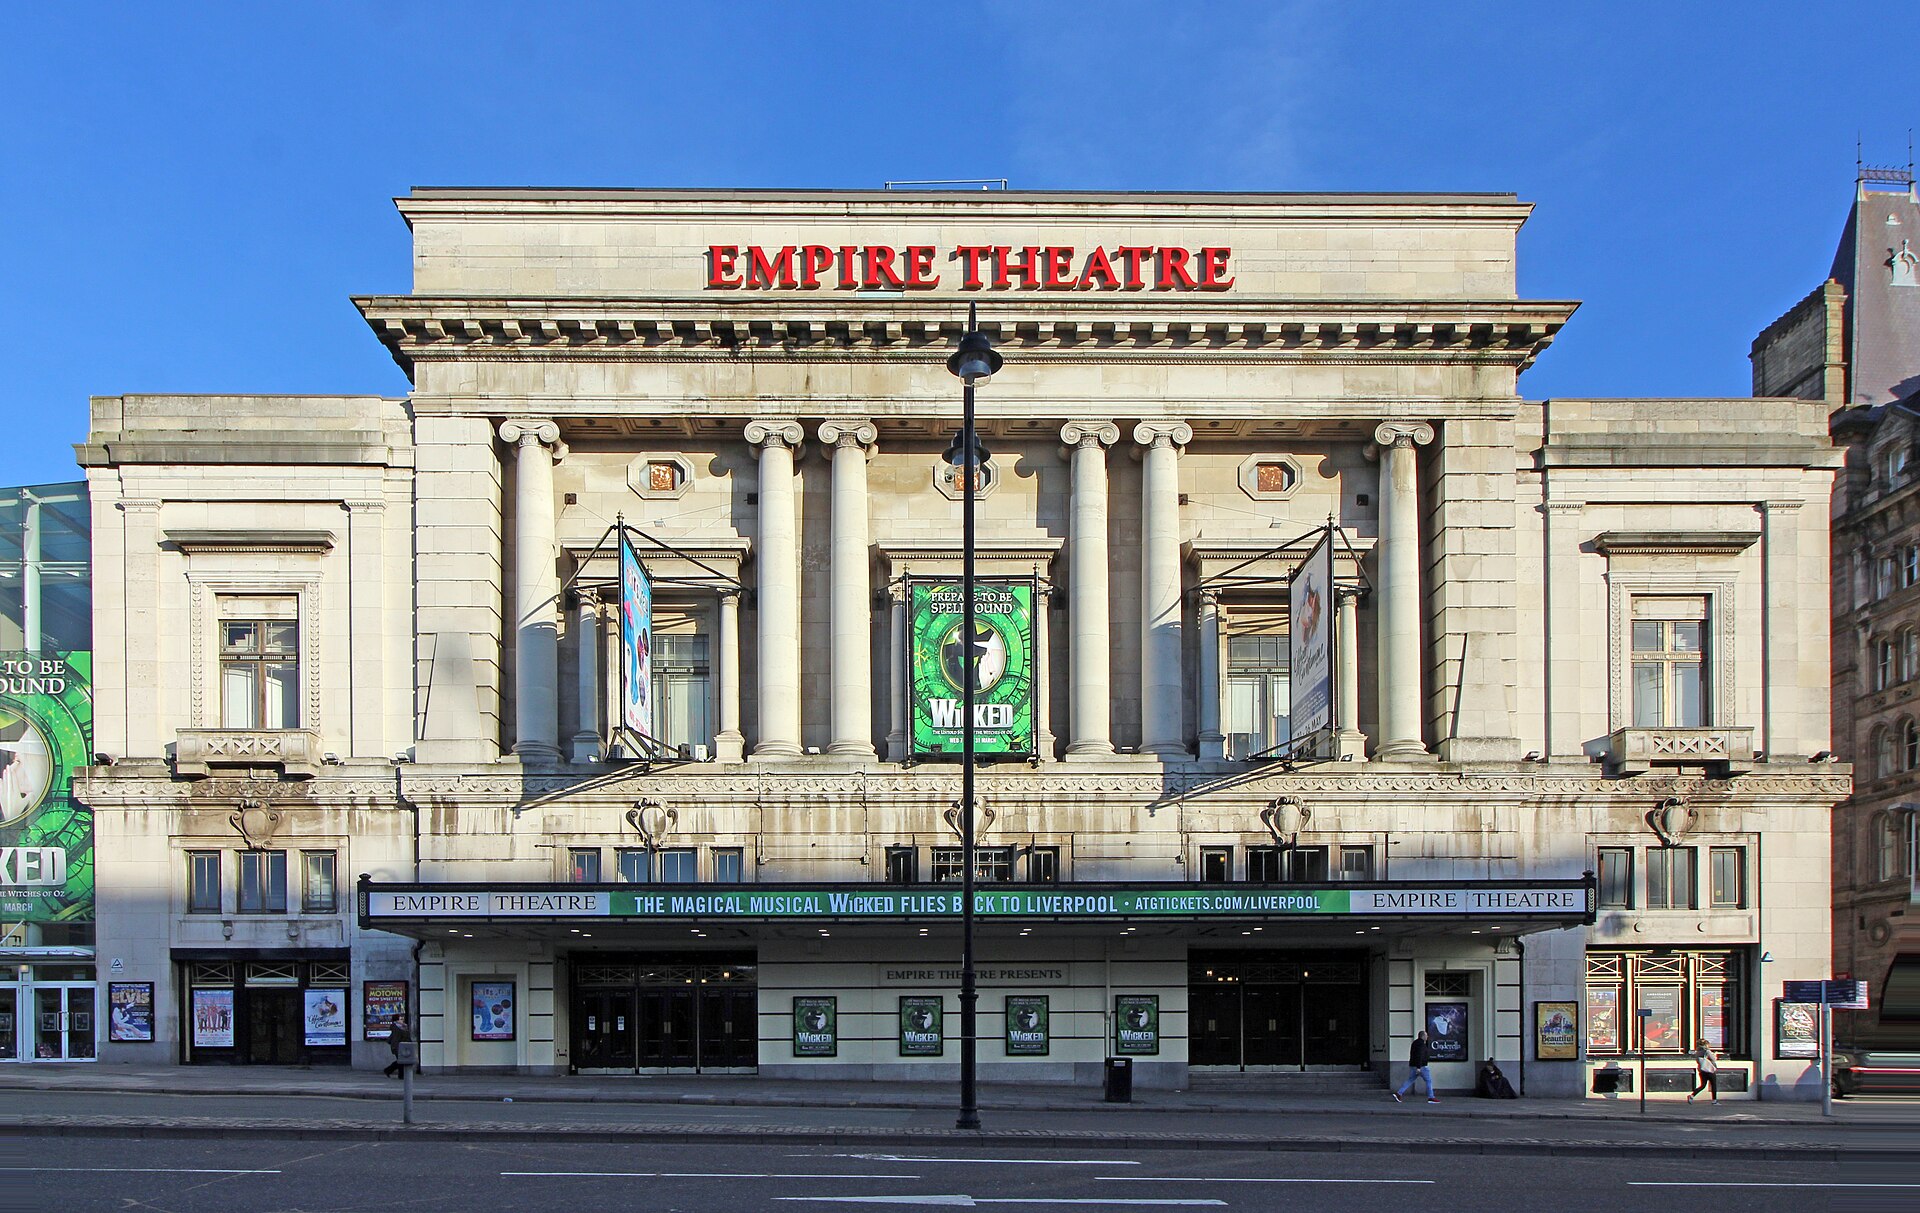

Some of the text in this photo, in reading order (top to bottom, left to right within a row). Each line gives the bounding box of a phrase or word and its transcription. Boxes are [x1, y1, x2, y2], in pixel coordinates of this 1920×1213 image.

[707, 245, 1236, 291] EMPIRE THEATRE
[931, 592, 1013, 602] PREPAE TO BE
[931, 603, 1013, 614] SPELLOUND
[3, 660, 66, 675] TO BE
[928, 698, 1014, 728] WIKED
[53, 890, 65, 898] OZ
[1372, 892, 1575, 908] EMPIRE THEATRE
[4, 902, 33, 912] MARCH
[392, 895, 597, 912] EMPIRE THEATRE
[634, 896, 667, 914] THE
[670, 896, 745, 914] MAGICAL
[749, 896, 823, 914] MUSICAL
[901, 896, 947, 914] FLIES
[952, 896, 995, 913] BCK
[1001, 896, 1022, 914] TO
[1026, 895, 1119, 913] LIVERPOOL
[1134, 896, 1321, 912] ATGTICKETS.COM/LIVERPOOL
[886, 969, 1063, 980] EMPIRE THETRE PRESENTS
[111, 991, 150, 1004] ELVIS
[1541, 1034, 1574, 1042] Beautiful
